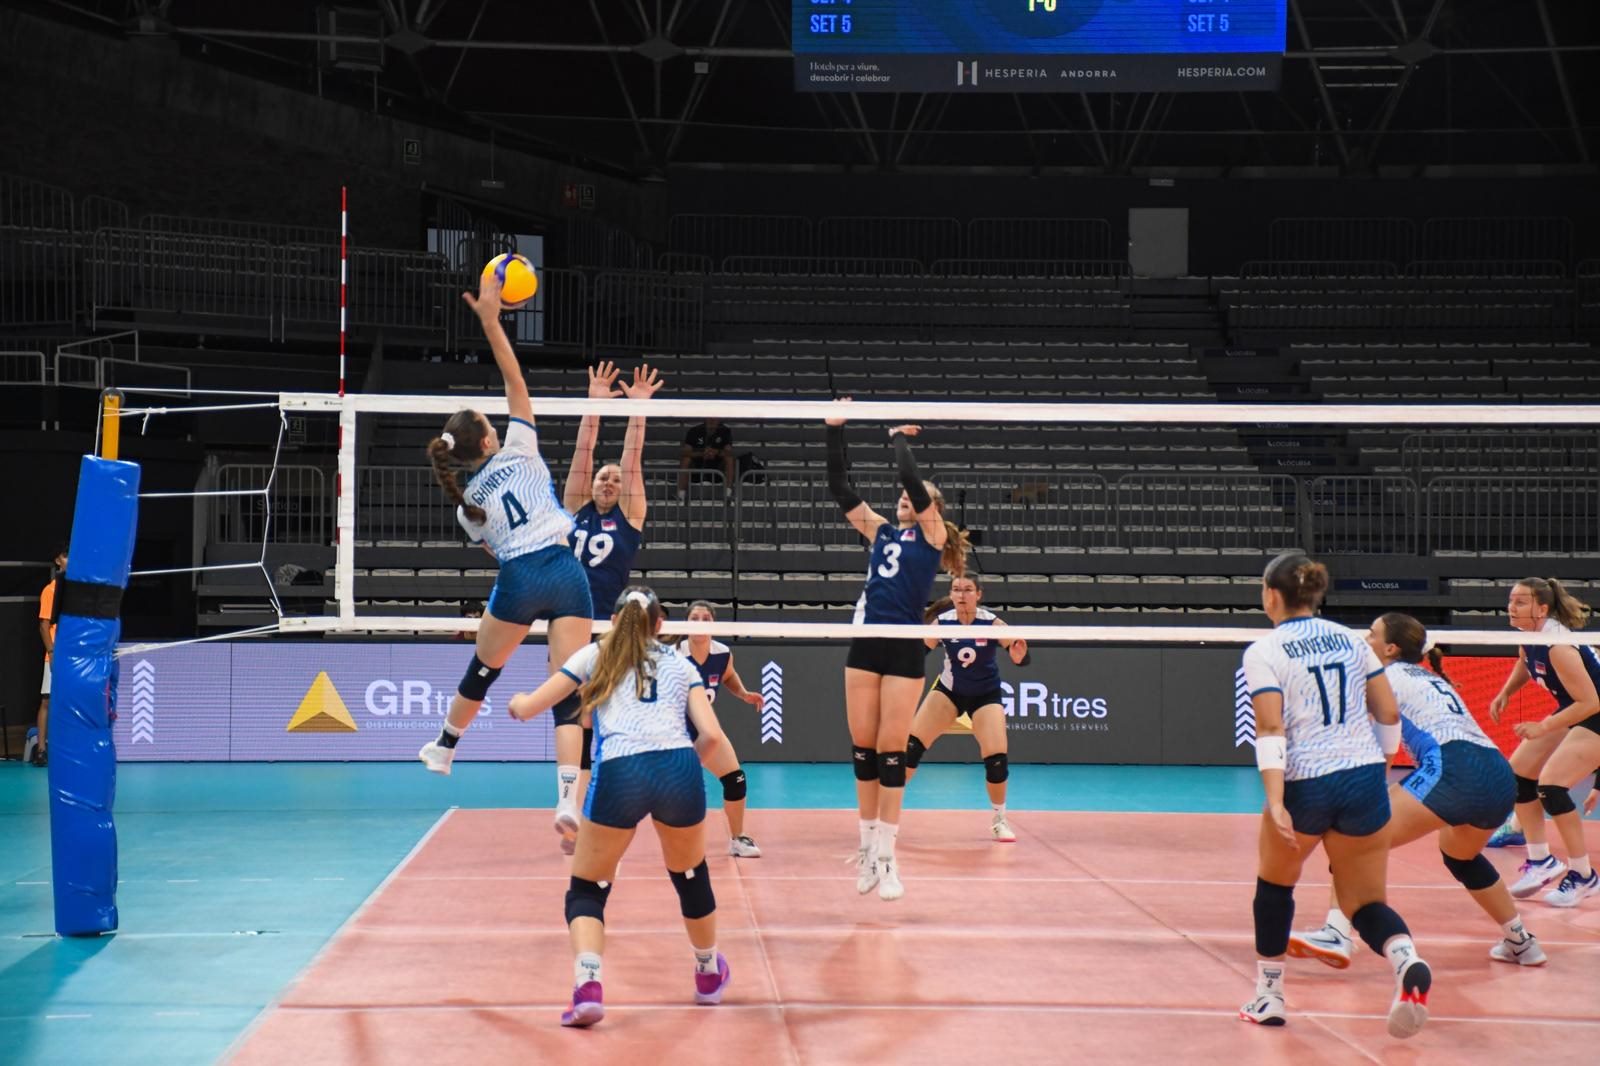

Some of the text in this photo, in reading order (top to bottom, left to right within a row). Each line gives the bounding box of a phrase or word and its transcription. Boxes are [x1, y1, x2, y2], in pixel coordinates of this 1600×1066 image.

[810, 14, 851, 33] SET 5
[1188, 14, 1229, 32] SET 5
[810, 61, 835, 71] Hotels
[836, 63, 849, 72] per
[985, 69, 1117, 78] HESPERIA ANDORRA
[1178, 67, 1266, 77] HESPERIA.COM
[810, 73, 850, 82] descobrir
[855, 73, 891, 82] celebrar
[501, 490, 529, 530] 4
[574, 529, 614, 567] 19
[878, 542, 902, 578] 3
[957, 647, 976, 668] 9
[1307, 662, 1346, 726] 17
[1429, 680, 1464, 715] 5
